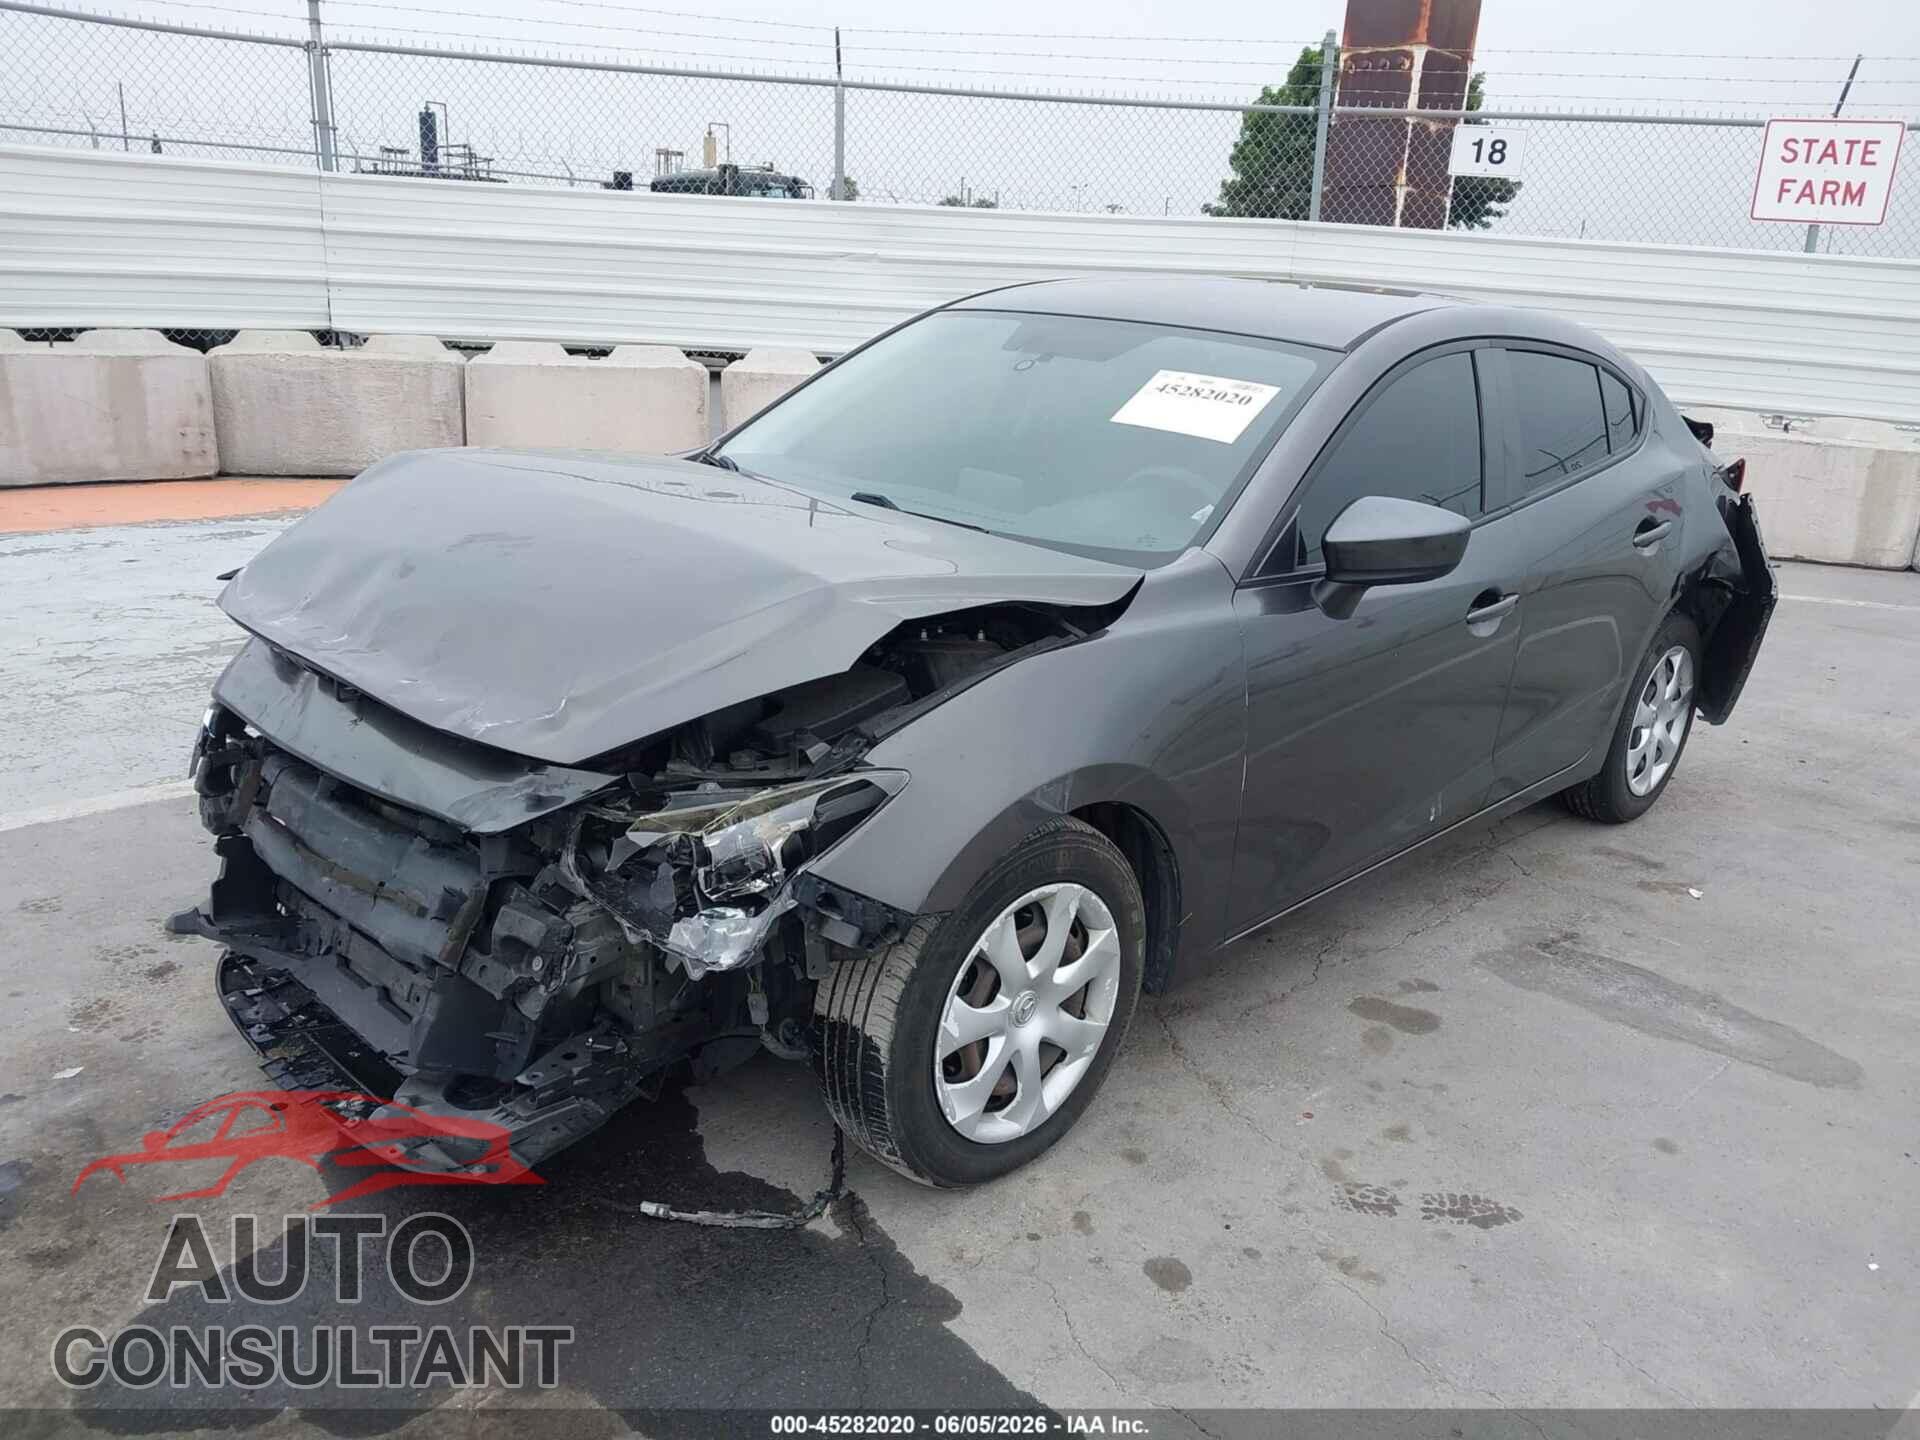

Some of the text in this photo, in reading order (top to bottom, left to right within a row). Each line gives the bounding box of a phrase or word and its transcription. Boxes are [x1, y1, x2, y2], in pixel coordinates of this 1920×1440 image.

[1472, 138, 1507, 164] 18
[1781, 138, 1881, 166] STATE
[1777, 179, 1867, 206] FARM
[1155, 383, 1253, 405] 45282020
